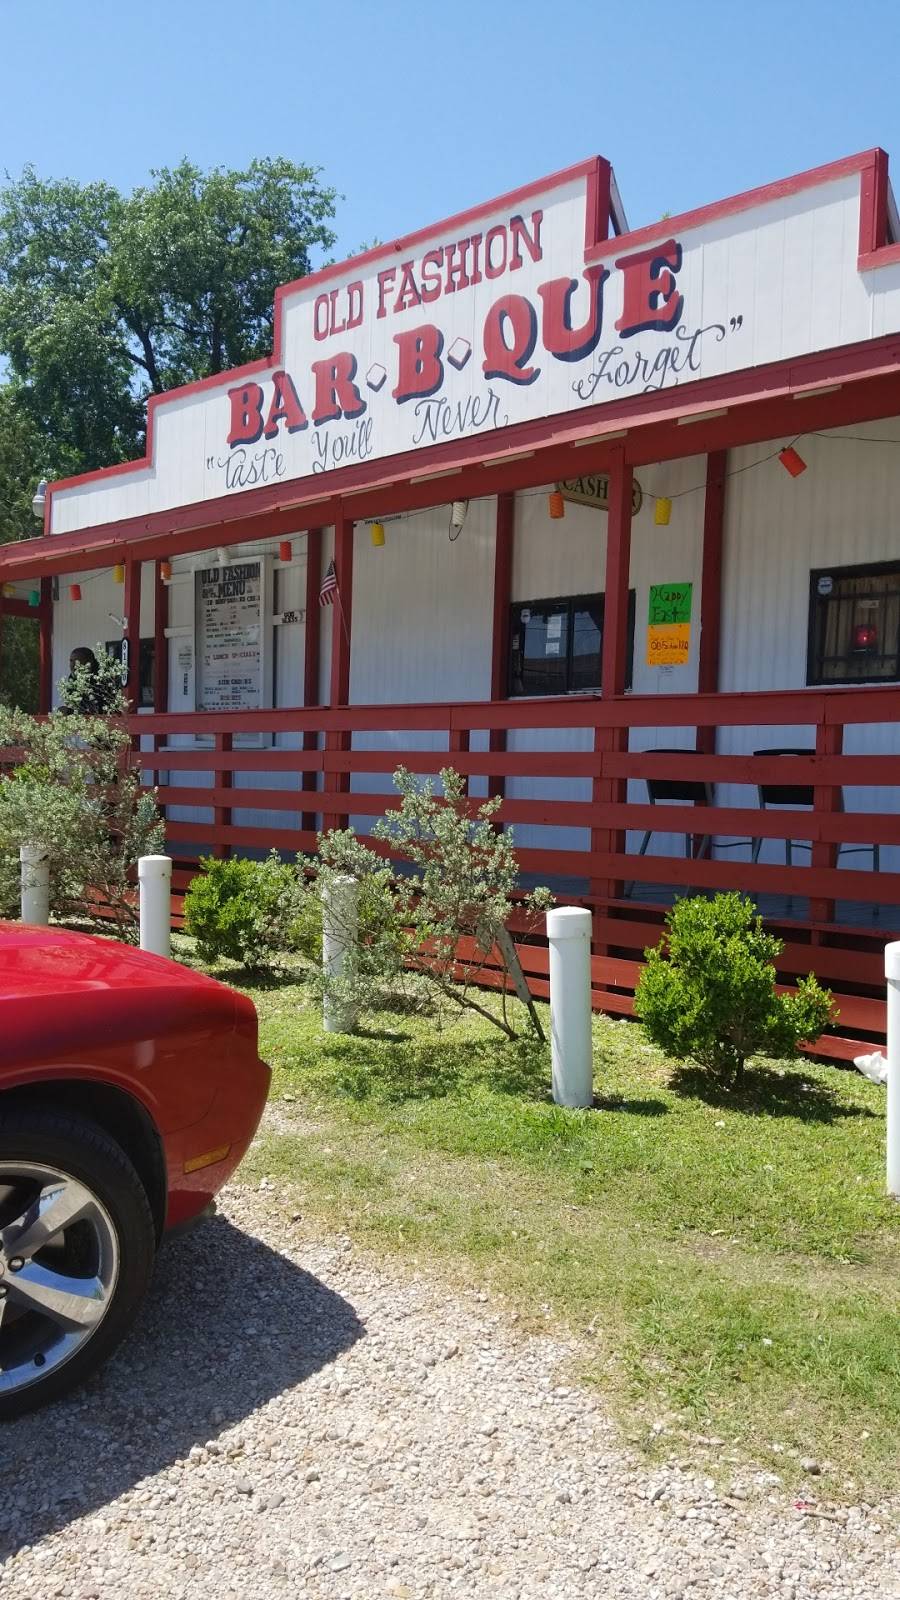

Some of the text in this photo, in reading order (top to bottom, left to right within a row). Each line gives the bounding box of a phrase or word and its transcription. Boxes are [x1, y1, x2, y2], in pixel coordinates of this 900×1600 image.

[313, 210, 544, 341] OLD FASHION
[311, 416, 374, 474] You'll
[412, 387, 510, 445] Never
